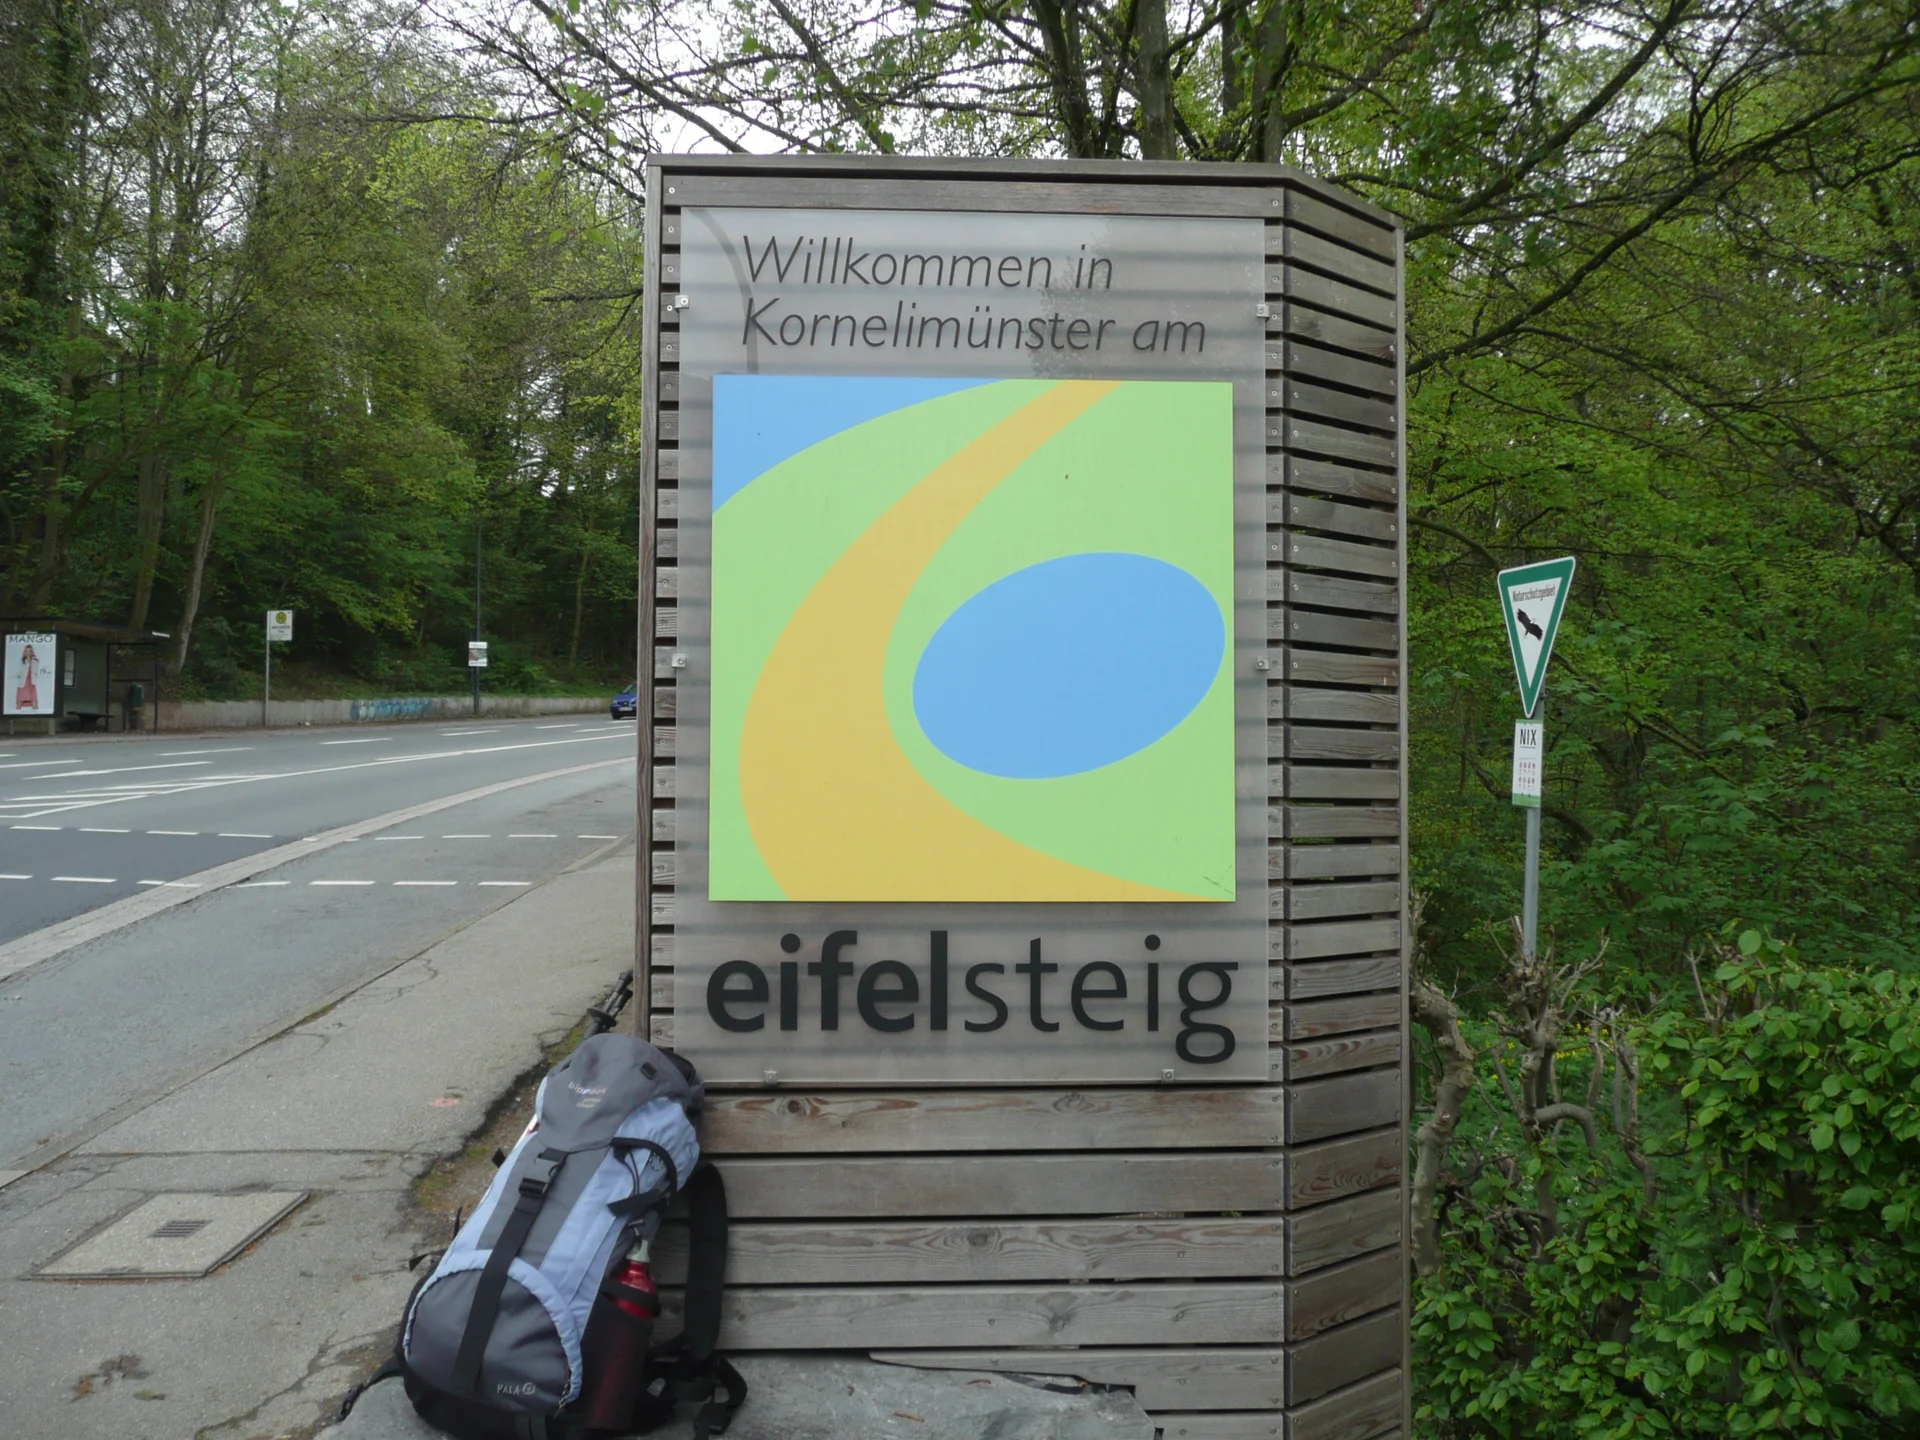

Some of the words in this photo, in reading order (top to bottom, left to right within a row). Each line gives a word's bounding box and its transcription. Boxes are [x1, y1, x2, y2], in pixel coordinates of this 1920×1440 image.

[742, 235, 1052, 288] Willkommen
[1075, 244, 1113, 290] in
[742, 297, 1116, 351] Kornelimünster
[1132, 318, 1206, 353] am
[9, 634, 53, 644] MANGO
[1520, 728, 1537, 746] NIX
[706, 930, 1239, 1064] eifelsteig
